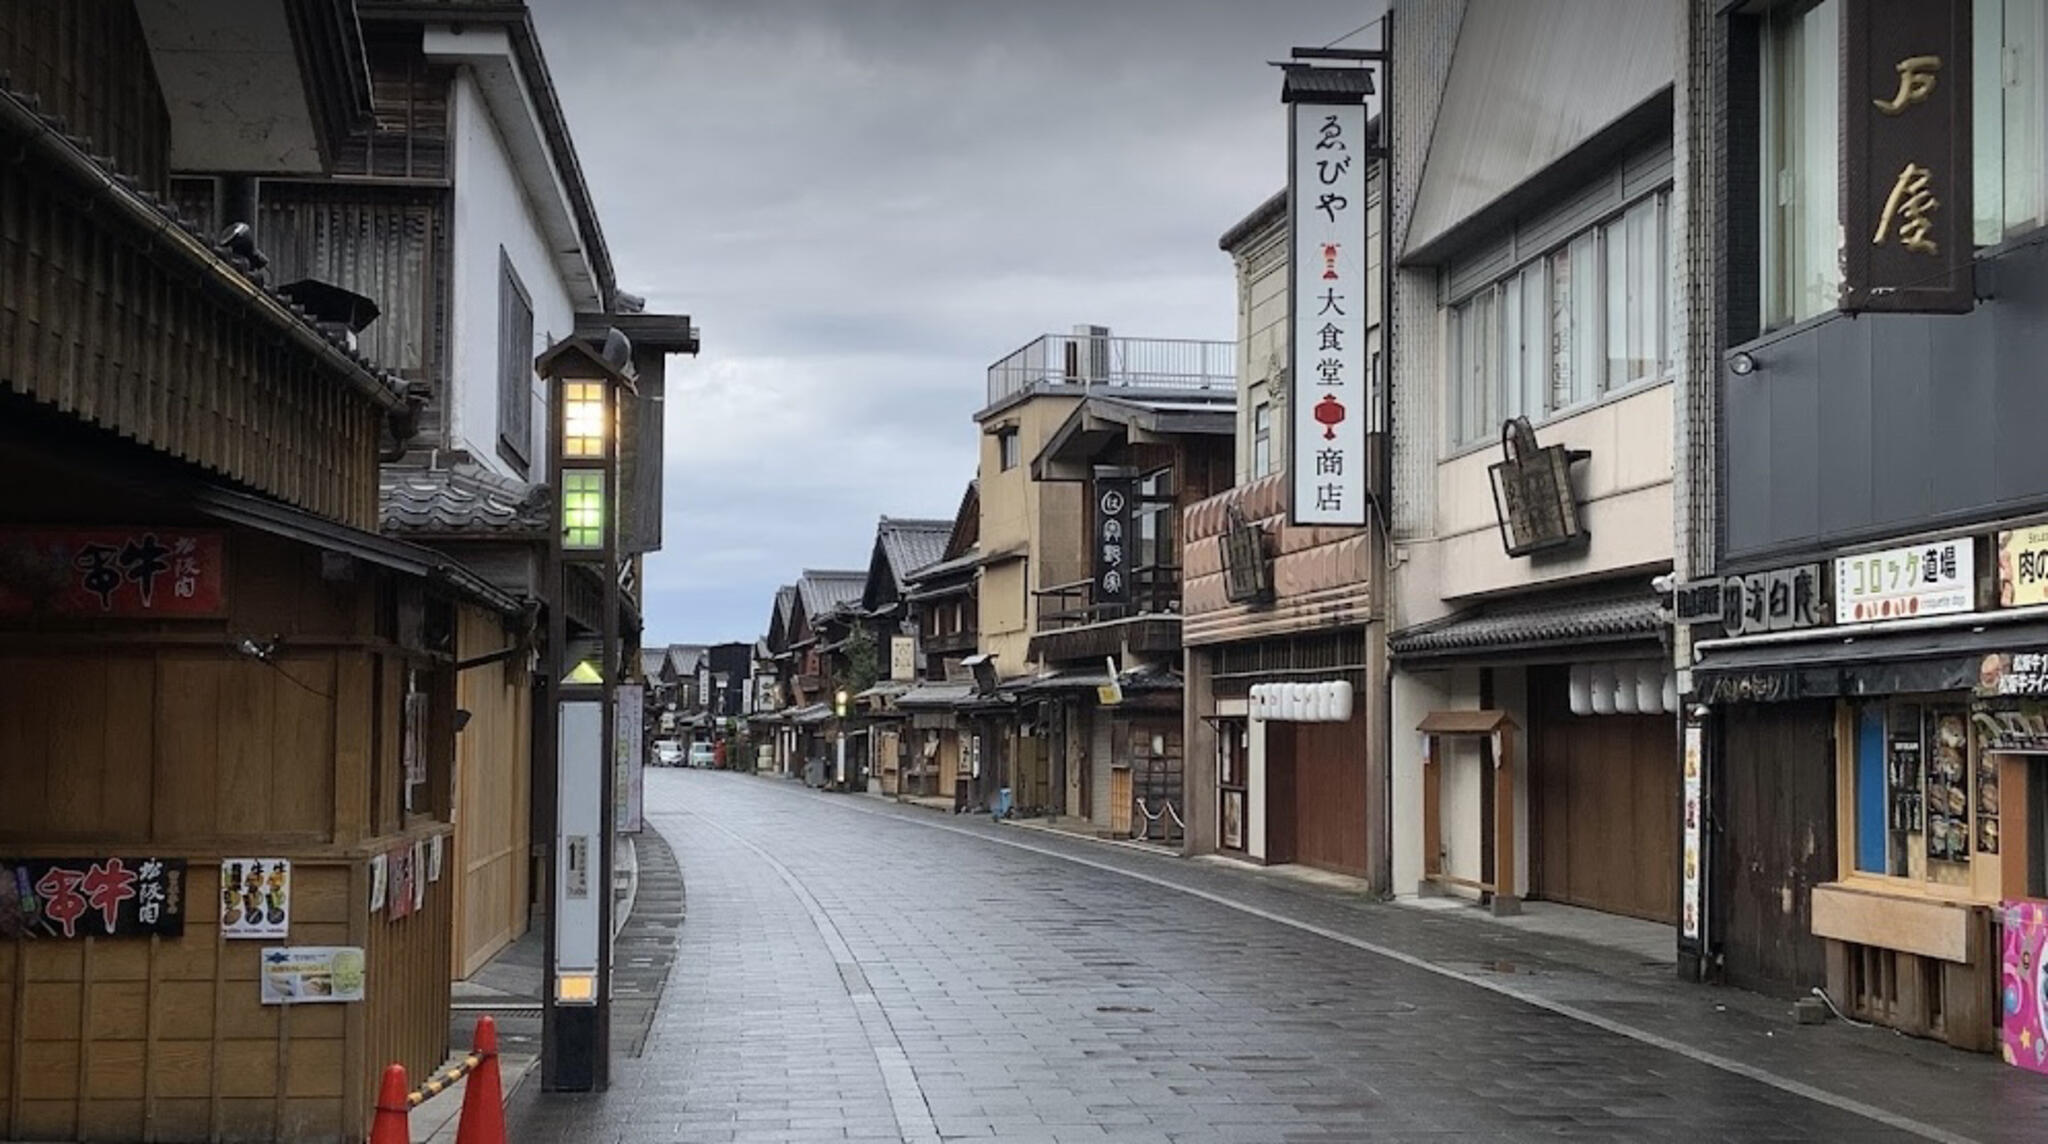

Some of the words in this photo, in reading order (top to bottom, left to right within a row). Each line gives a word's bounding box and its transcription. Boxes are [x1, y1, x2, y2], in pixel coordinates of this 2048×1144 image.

[1315, 115, 1351, 223] ゑびや
[1315, 287, 1345, 387] 大食堂
[1315, 448, 1345, 512] 商店
[138, 857, 165, 925] 松阪肉
